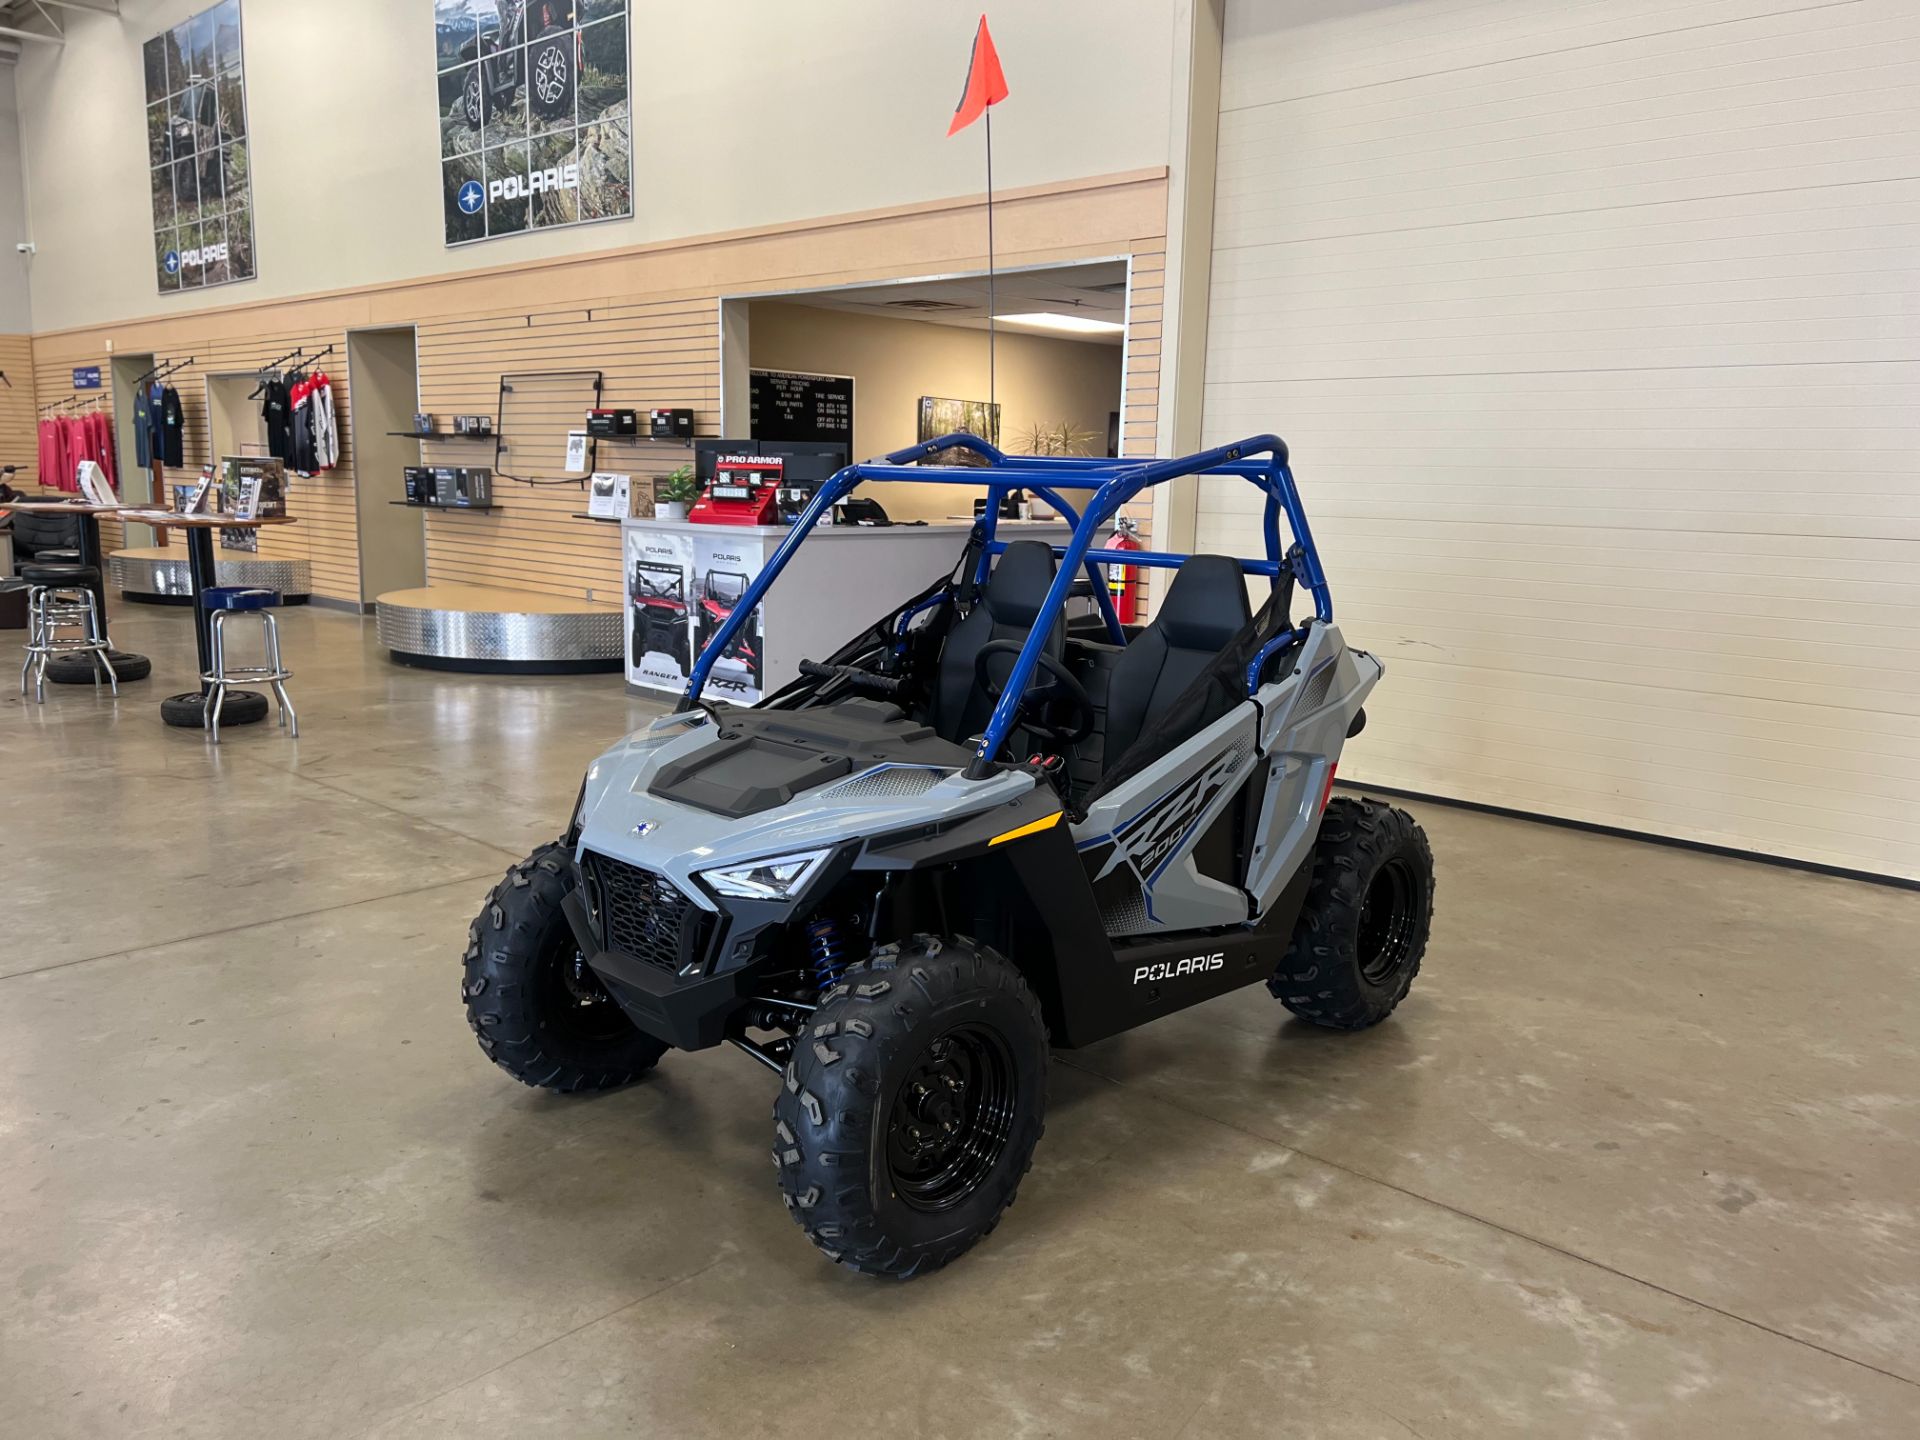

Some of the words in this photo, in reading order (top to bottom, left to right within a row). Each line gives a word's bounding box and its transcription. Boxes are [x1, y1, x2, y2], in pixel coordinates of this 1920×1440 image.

[489, 164, 577, 204] POLARIS
[181, 242, 228, 268] POLARIS
[725, 455, 746, 464] PRO
[747, 456, 783, 465] ARMOR
[645, 546, 673, 555] POLARIS
[712, 553, 742, 562] POLARIS
[642, 669, 679, 681] RANGER
[708, 676, 748, 693] RZR
[1093, 755, 1240, 883] RZR
[1140, 826, 1185, 871] 200
[1133, 952, 1225, 985] POLARIS
